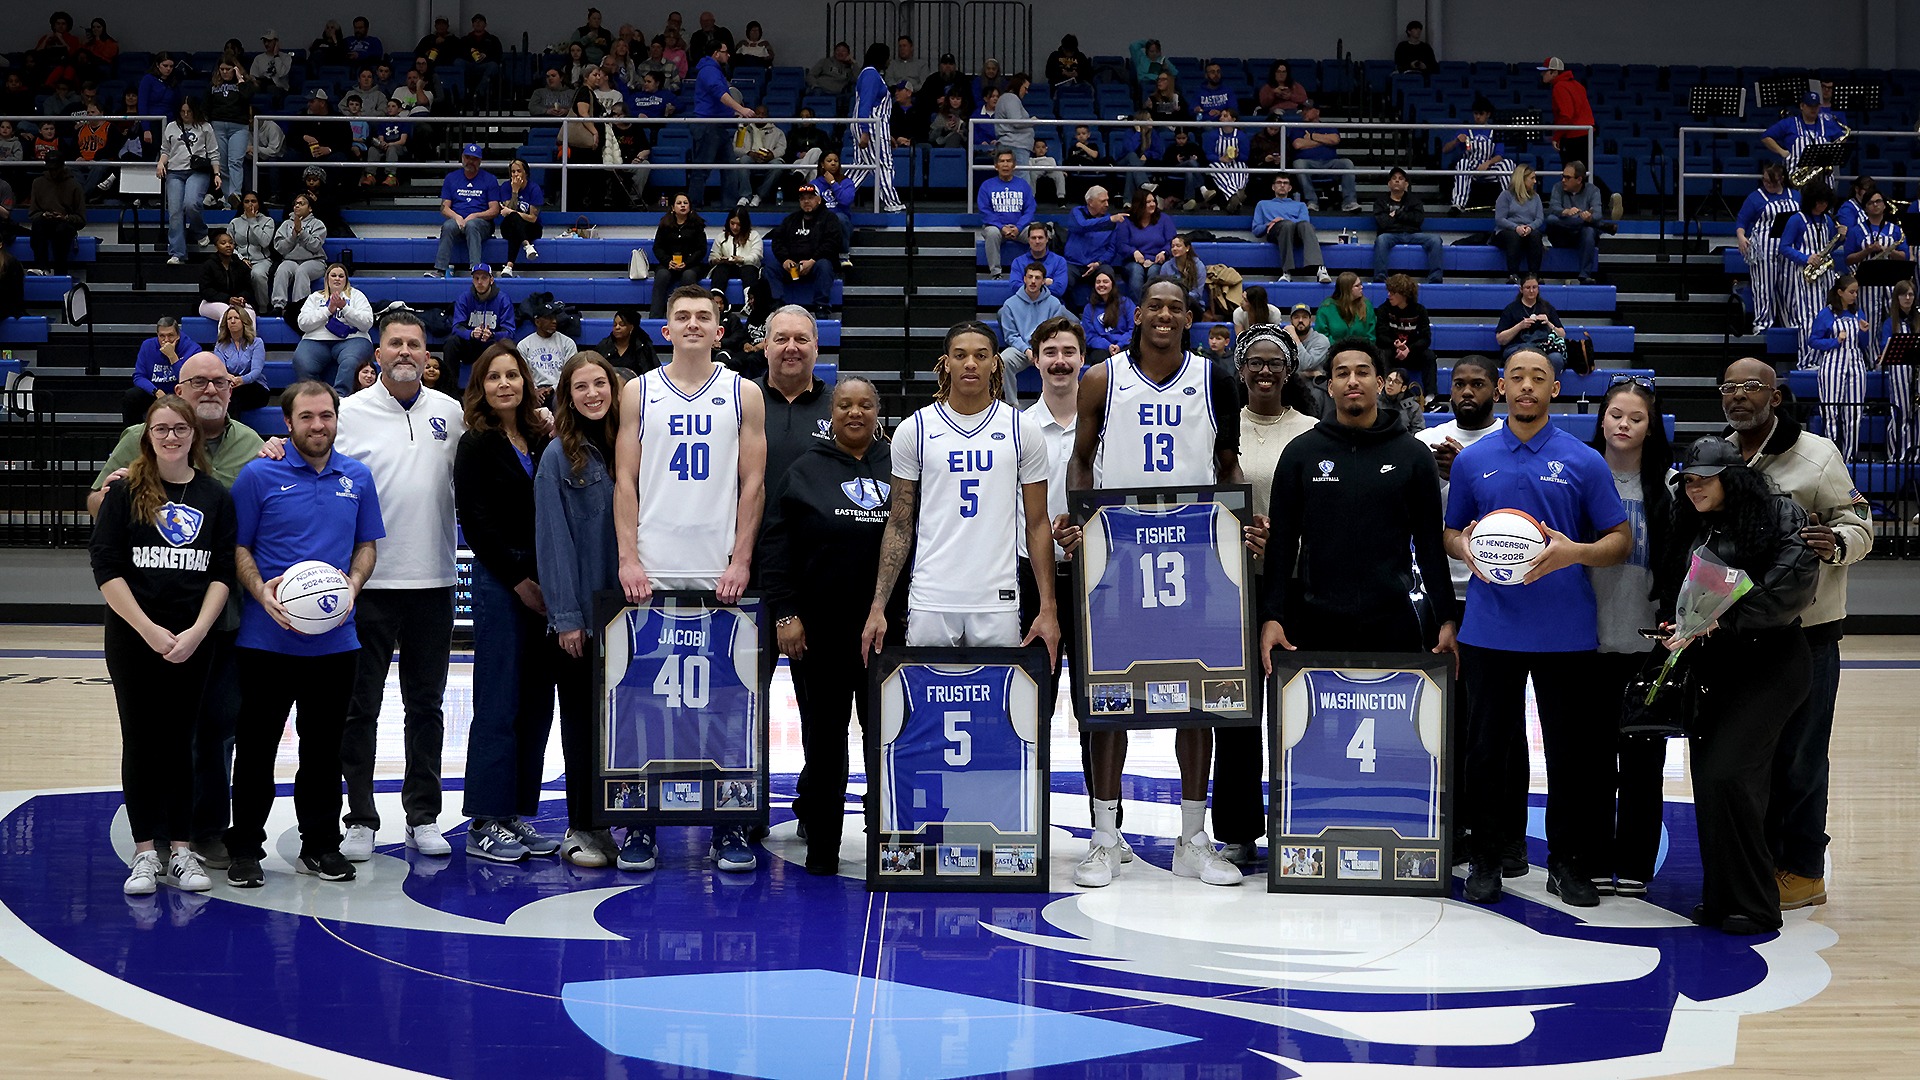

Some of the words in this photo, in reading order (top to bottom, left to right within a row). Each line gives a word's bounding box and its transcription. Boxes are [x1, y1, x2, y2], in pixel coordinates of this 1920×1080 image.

[991, 191, 1023, 199] EASTERN
[991, 198, 1023, 206] ILLINOIS
[668, 415, 712, 436] EIU
[1138, 404, 1181, 427] EIU
[669, 442, 710, 481] 40
[947, 450, 994, 473] EIU
[1143, 433, 1175, 472] 13
[959, 479, 980, 519] 5
[834, 509, 870, 517] EASTERN
[871, 510, 893, 518] ILLIN
[1136, 525, 1186, 545] FISHER
[1486, 539, 1530, 551] HENDERSON
[1479, 550, 1525, 560] 2024-2026
[297, 570, 318, 582] NOAH
[1140, 552, 1186, 608] 13
[658, 628, 706, 647] JACOBI
[653, 654, 711, 709] 40
[927, 684, 990, 703] FRUSTER
[1320, 692, 1406, 710] WASHINGTON
[944, 710, 972, 766] 5
[1346, 717, 1377, 773] 4
